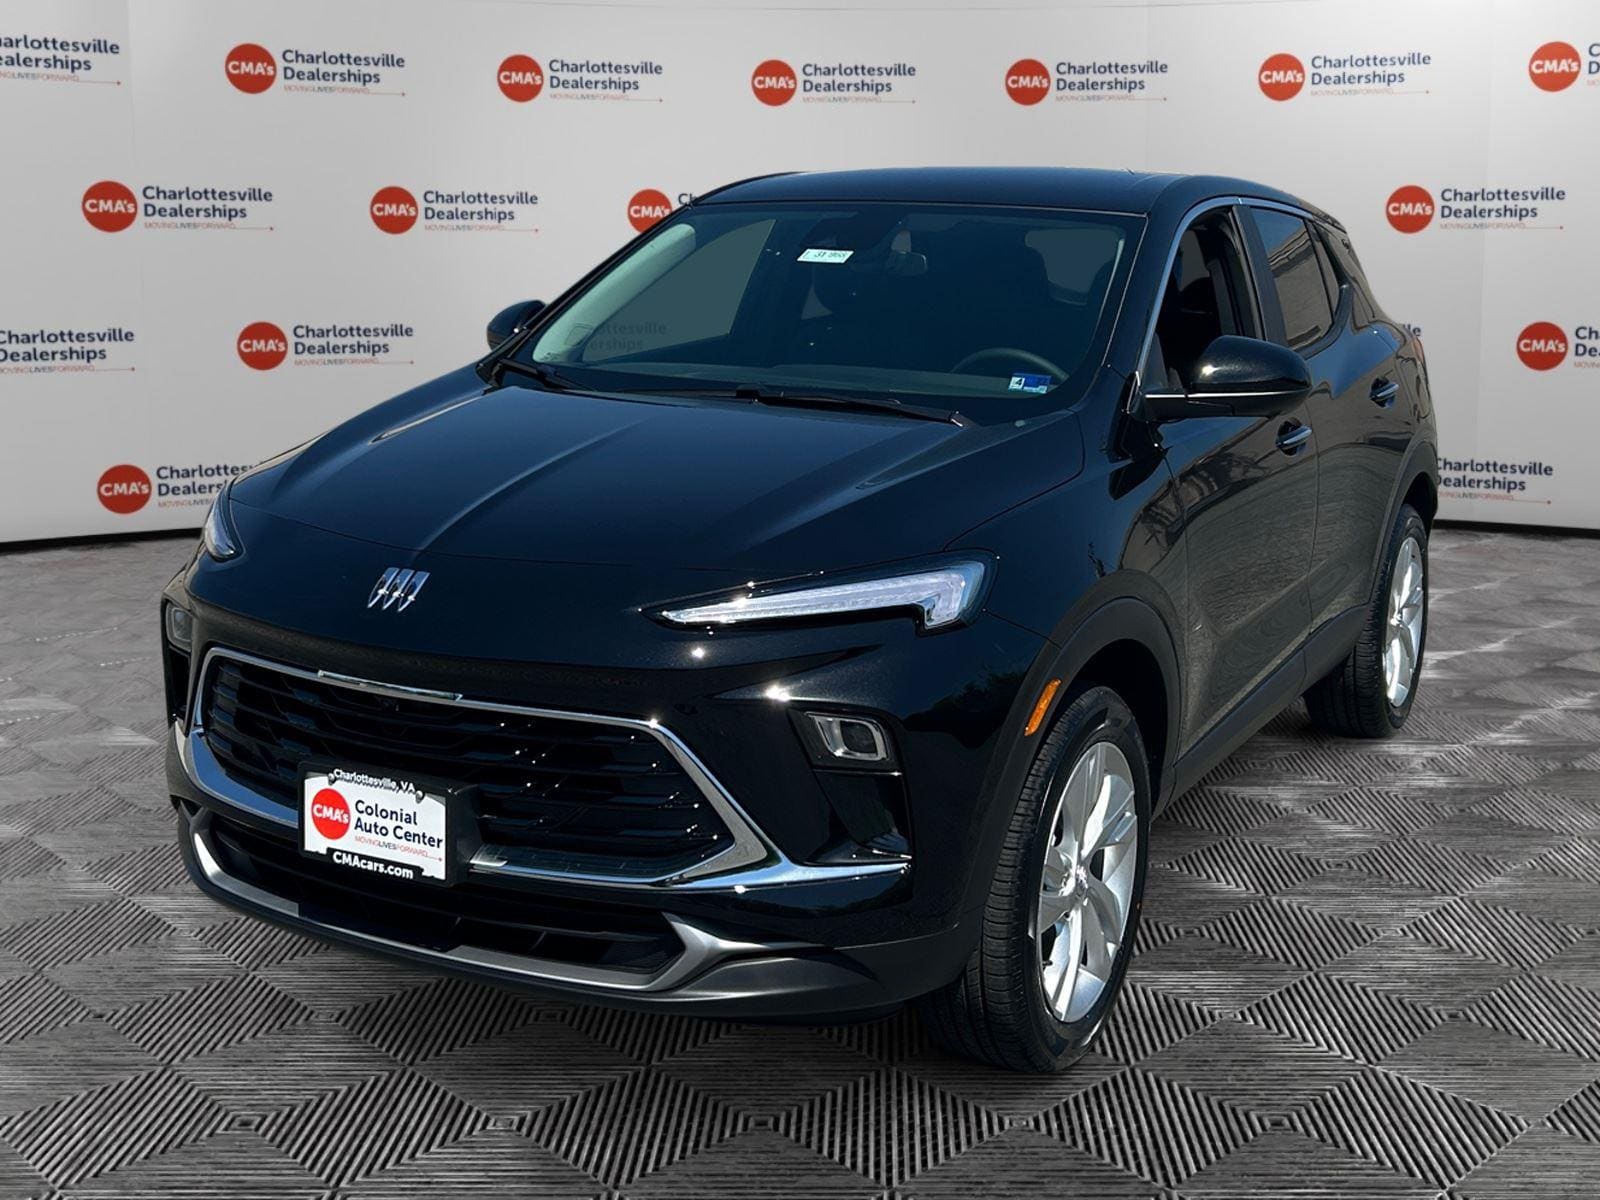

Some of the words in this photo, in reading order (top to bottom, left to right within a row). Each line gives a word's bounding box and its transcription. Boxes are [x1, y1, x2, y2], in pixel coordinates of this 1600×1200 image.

[0, 34, 120, 54] arlottesville
[0, 52, 92, 74] alerships
[281, 49, 405, 68] Charlottesville
[1311, 52, 1431, 69] Charlottesville
[1531, 58, 1579, 74] CMA's
[228, 61, 274, 76] CMA's
[548, 59, 663, 75] Charlottesville
[802, 63, 917, 77] Charlottesville
[1055, 60, 1168, 75] Charlottesville
[283, 66, 381, 86] Dealerships
[500, 71, 542, 86] CMA's
[550, 75, 640, 93] Dealerships
[754, 76, 795, 89] CMA's
[1007, 75, 1049, 89] CMA's
[1260, 69, 1304, 84] CMA's
[1311, 70, 1405, 86] Dealerships
[802, 79, 893, 95] Dealerships
[1056, 77, 1145, 93] Dealerships
[142, 185, 273, 202] Charlottesville
[423, 190, 538, 205] Charlottesville
[1440, 186, 1566, 202] Charlottesville
[84, 199, 135, 213] CMA's
[143, 202, 247, 221] Dealerships
[372, 203, 416, 217] CMA's
[1388, 202, 1433, 216] CMA's
[1440, 204, 1538, 222] Dealerships
[424, 206, 515, 224] Dealerships
[292, 323, 414, 339] Charlottesville
[240, 339, 286, 353] CMA's
[294, 340, 390, 357] Dealerships
[1519, 339, 1566, 352] CMA's
[155, 464, 253, 480] Charlottes
[100, 481, 149, 496] CMA's
[157, 480, 229, 497] Dealers
[400, 780, 416, 794] VA
[312, 804, 349, 825] CMA's
[354, 799, 418, 826] Colonial
[354, 817, 389, 837] Auto
[393, 826, 443, 849] Center
[332, 851, 414, 880] CMAcars.com
